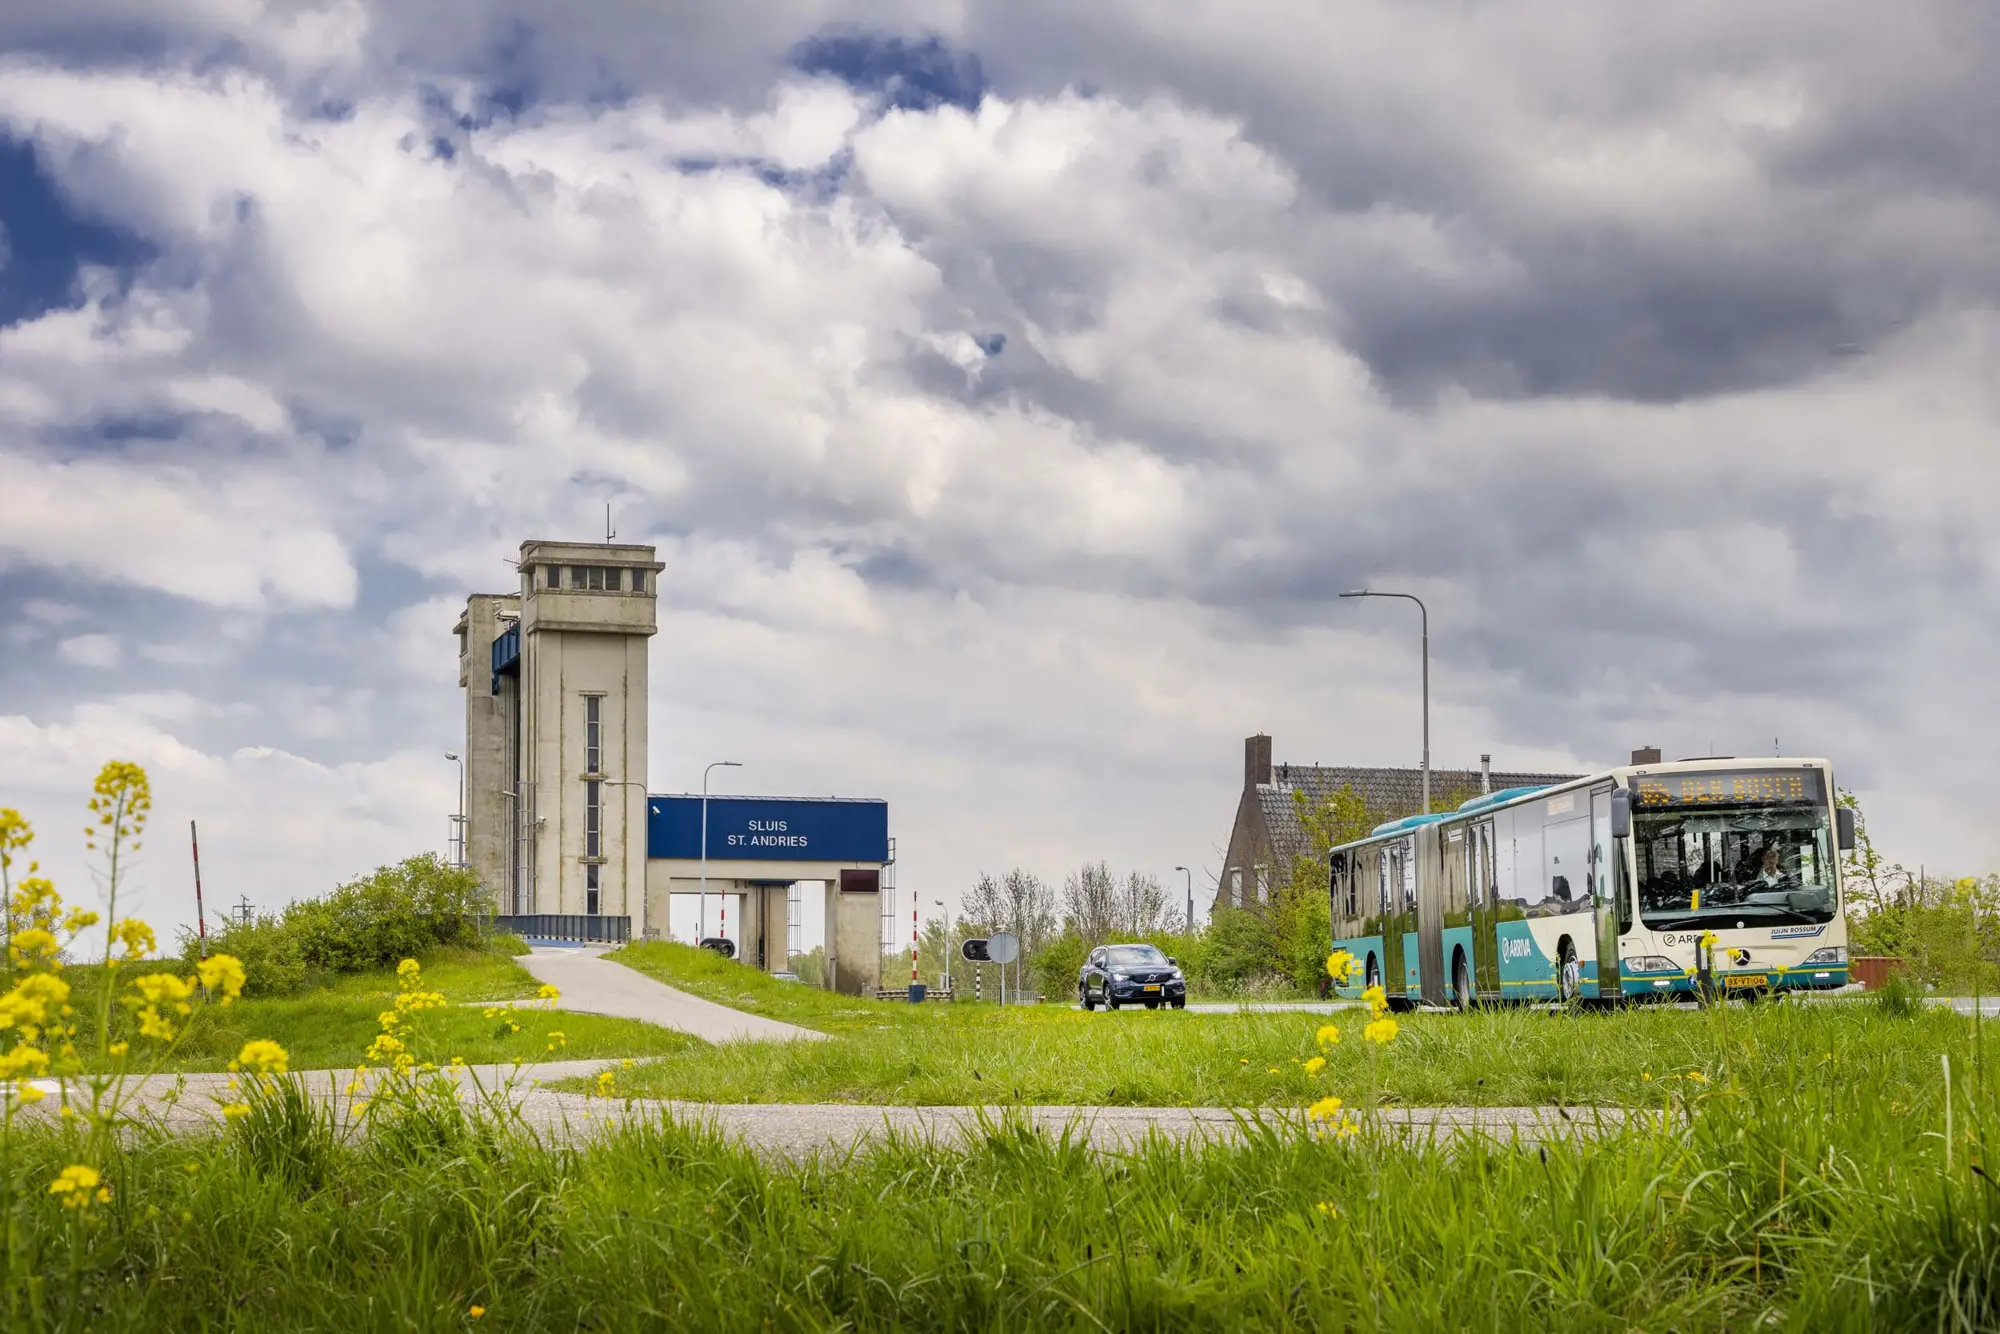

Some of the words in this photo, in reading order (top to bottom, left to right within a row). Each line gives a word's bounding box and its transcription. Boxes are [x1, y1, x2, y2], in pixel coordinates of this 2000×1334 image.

[748, 820, 788, 831] SLUIS
[727, 835, 747, 846] ST.
[750, 835, 808, 847] ANDRIES
[1510, 938, 1532, 957] ARRIVA
